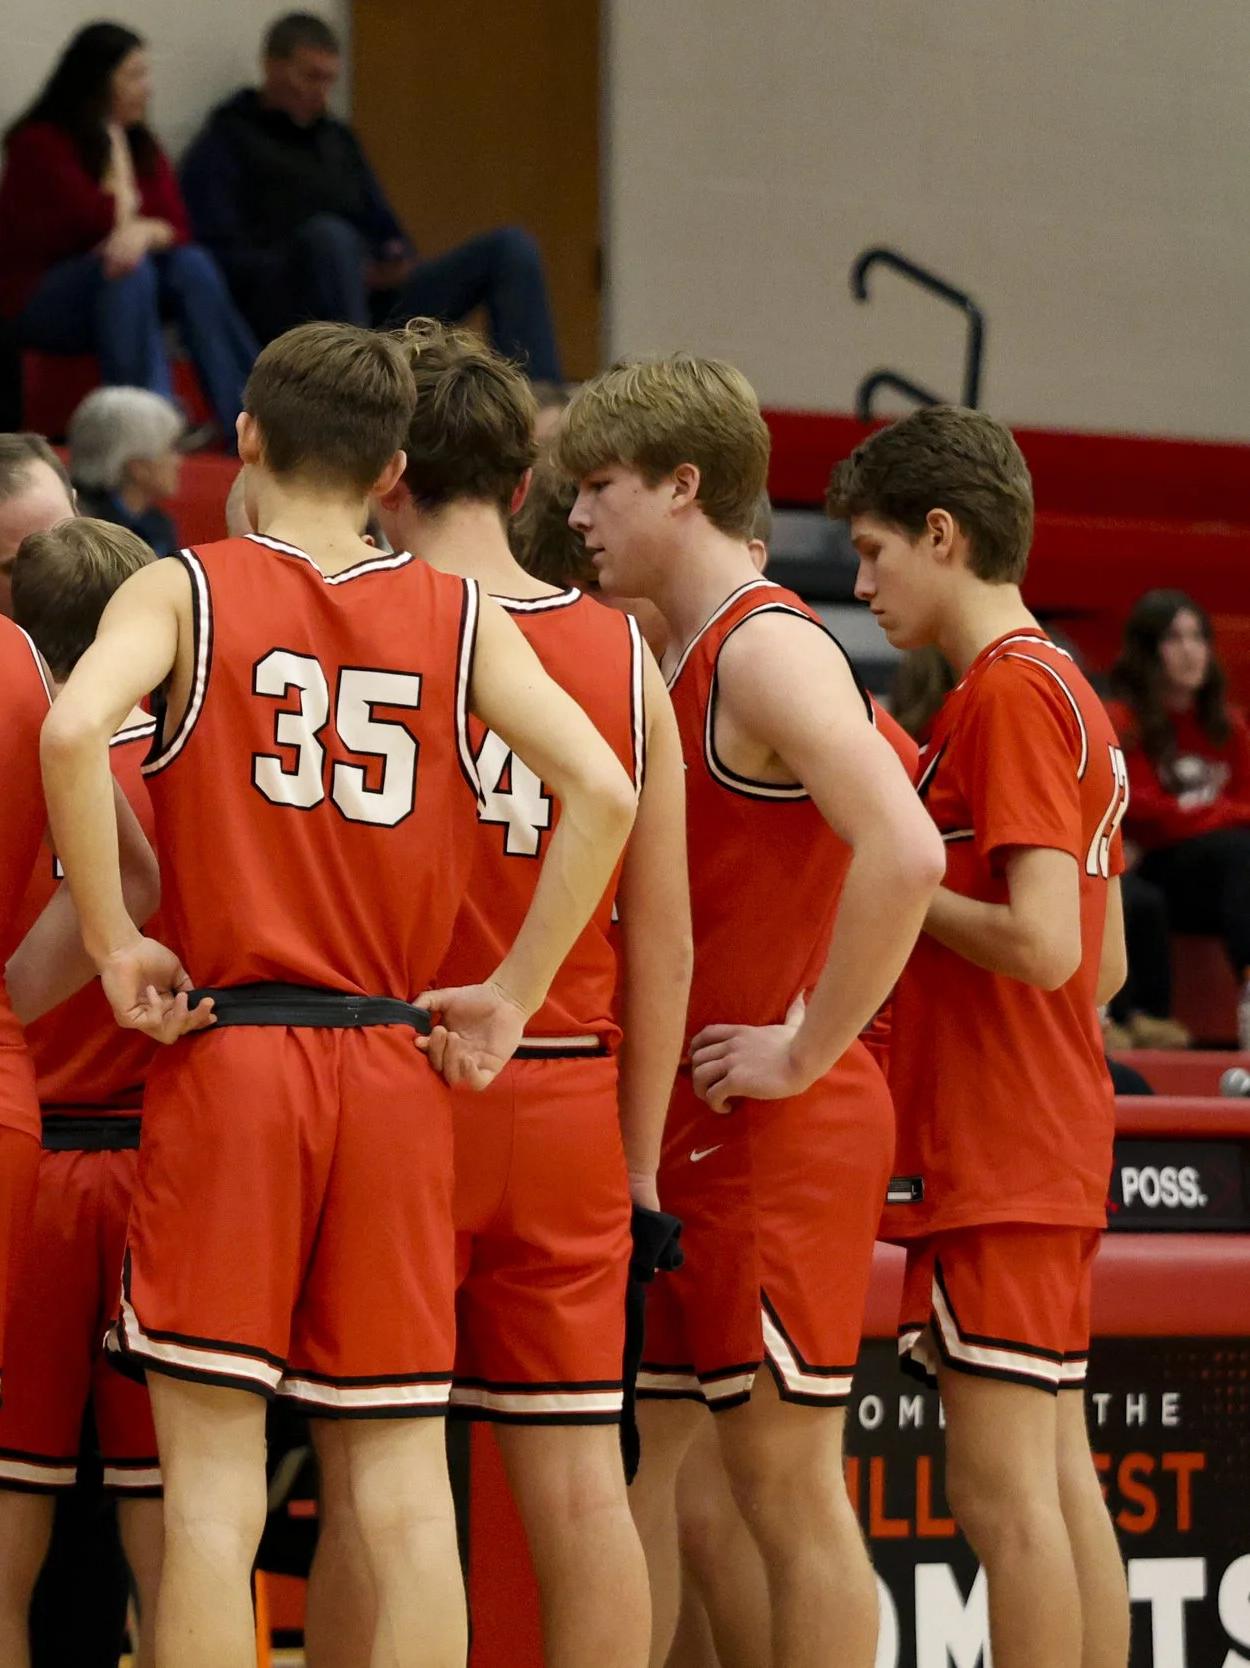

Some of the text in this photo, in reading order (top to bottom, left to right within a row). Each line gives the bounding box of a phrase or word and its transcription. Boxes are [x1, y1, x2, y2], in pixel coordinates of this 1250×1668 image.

[251, 647, 423, 829] 35
[1120, 1166, 1208, 1208] POSS.
[1092, 1392, 1182, 1427] THE
